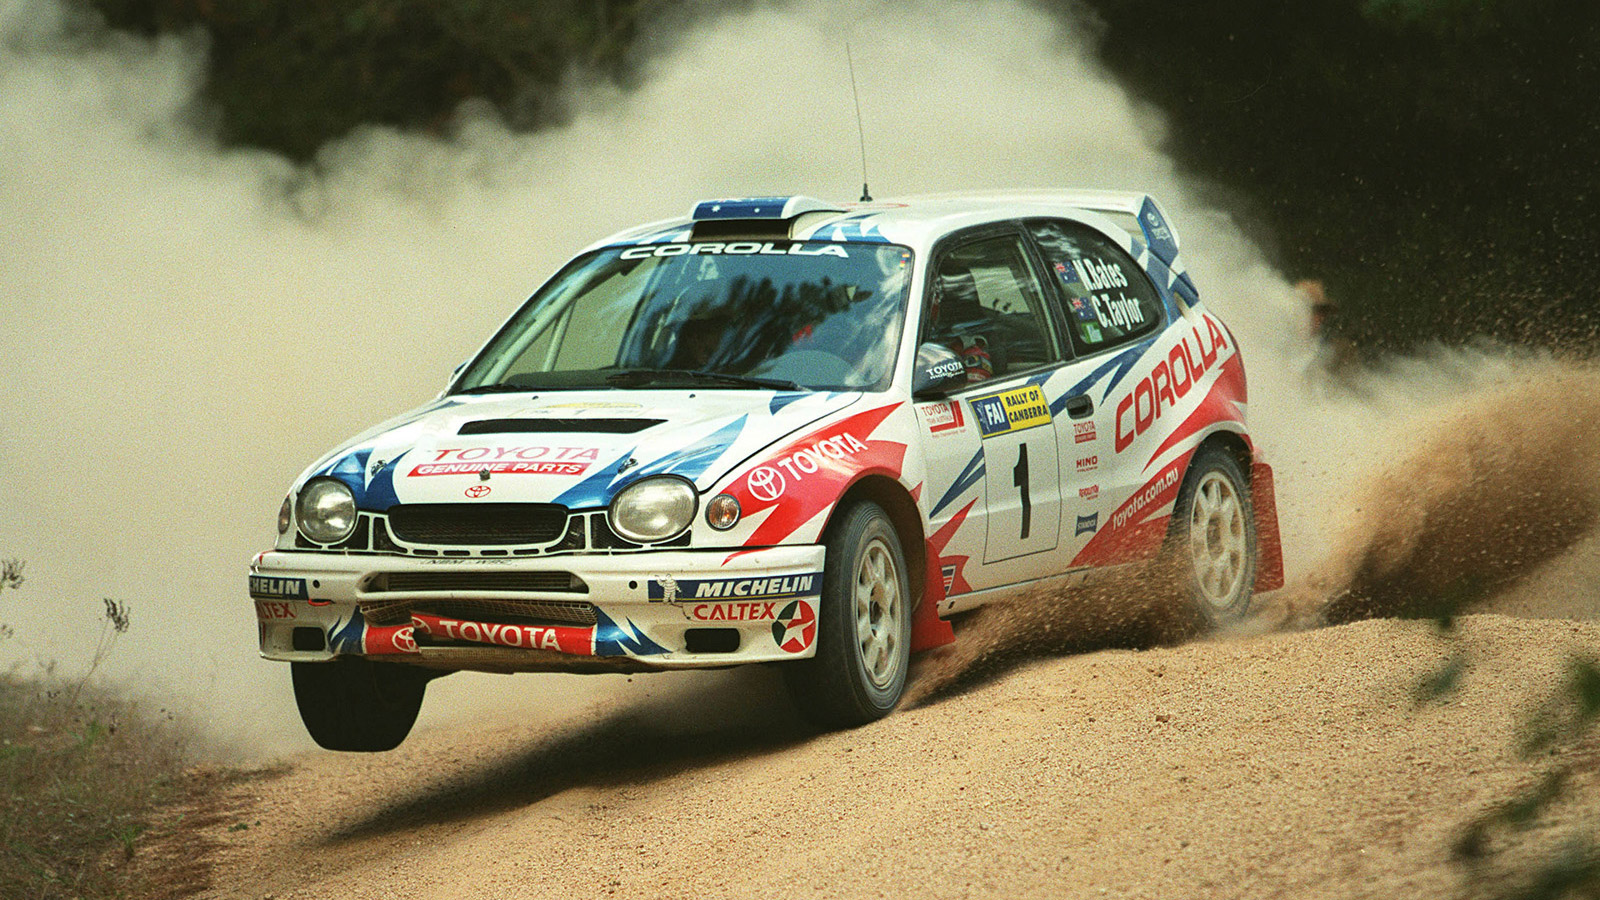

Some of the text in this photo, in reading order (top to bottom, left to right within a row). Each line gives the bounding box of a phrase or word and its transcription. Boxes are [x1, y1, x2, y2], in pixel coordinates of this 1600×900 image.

[620, 242, 849, 260] COROLLA
[1091, 292, 1145, 331] C.Taylor
[926, 361, 964, 376] TOYOTA
[1115, 313, 1228, 454] COROLLA
[1005, 390, 1040, 407] RALLY OF
[921, 403, 949, 417] TOYOTA
[984, 402, 1005, 426] FAI
[1009, 405, 1048, 423] CANBERRA
[1073, 421, 1096, 434] TOYOTA
[433, 446, 600, 462] TOYOTA
[777, 432, 868, 482] TOYOTA
[1076, 455, 1098, 468] HINO
[418, 462, 582, 475] GENUINE PARTS
[1013, 442, 1031, 540] 1
[1112, 466, 1180, 530] toyota.com.au
[250, 577, 300, 595] HELIN
[695, 575, 814, 598] MICHELIN
[256, 601, 297, 619] LTEX
[693, 602, 777, 621] CALTEX
[439, 619, 562, 652] TOYOTA
